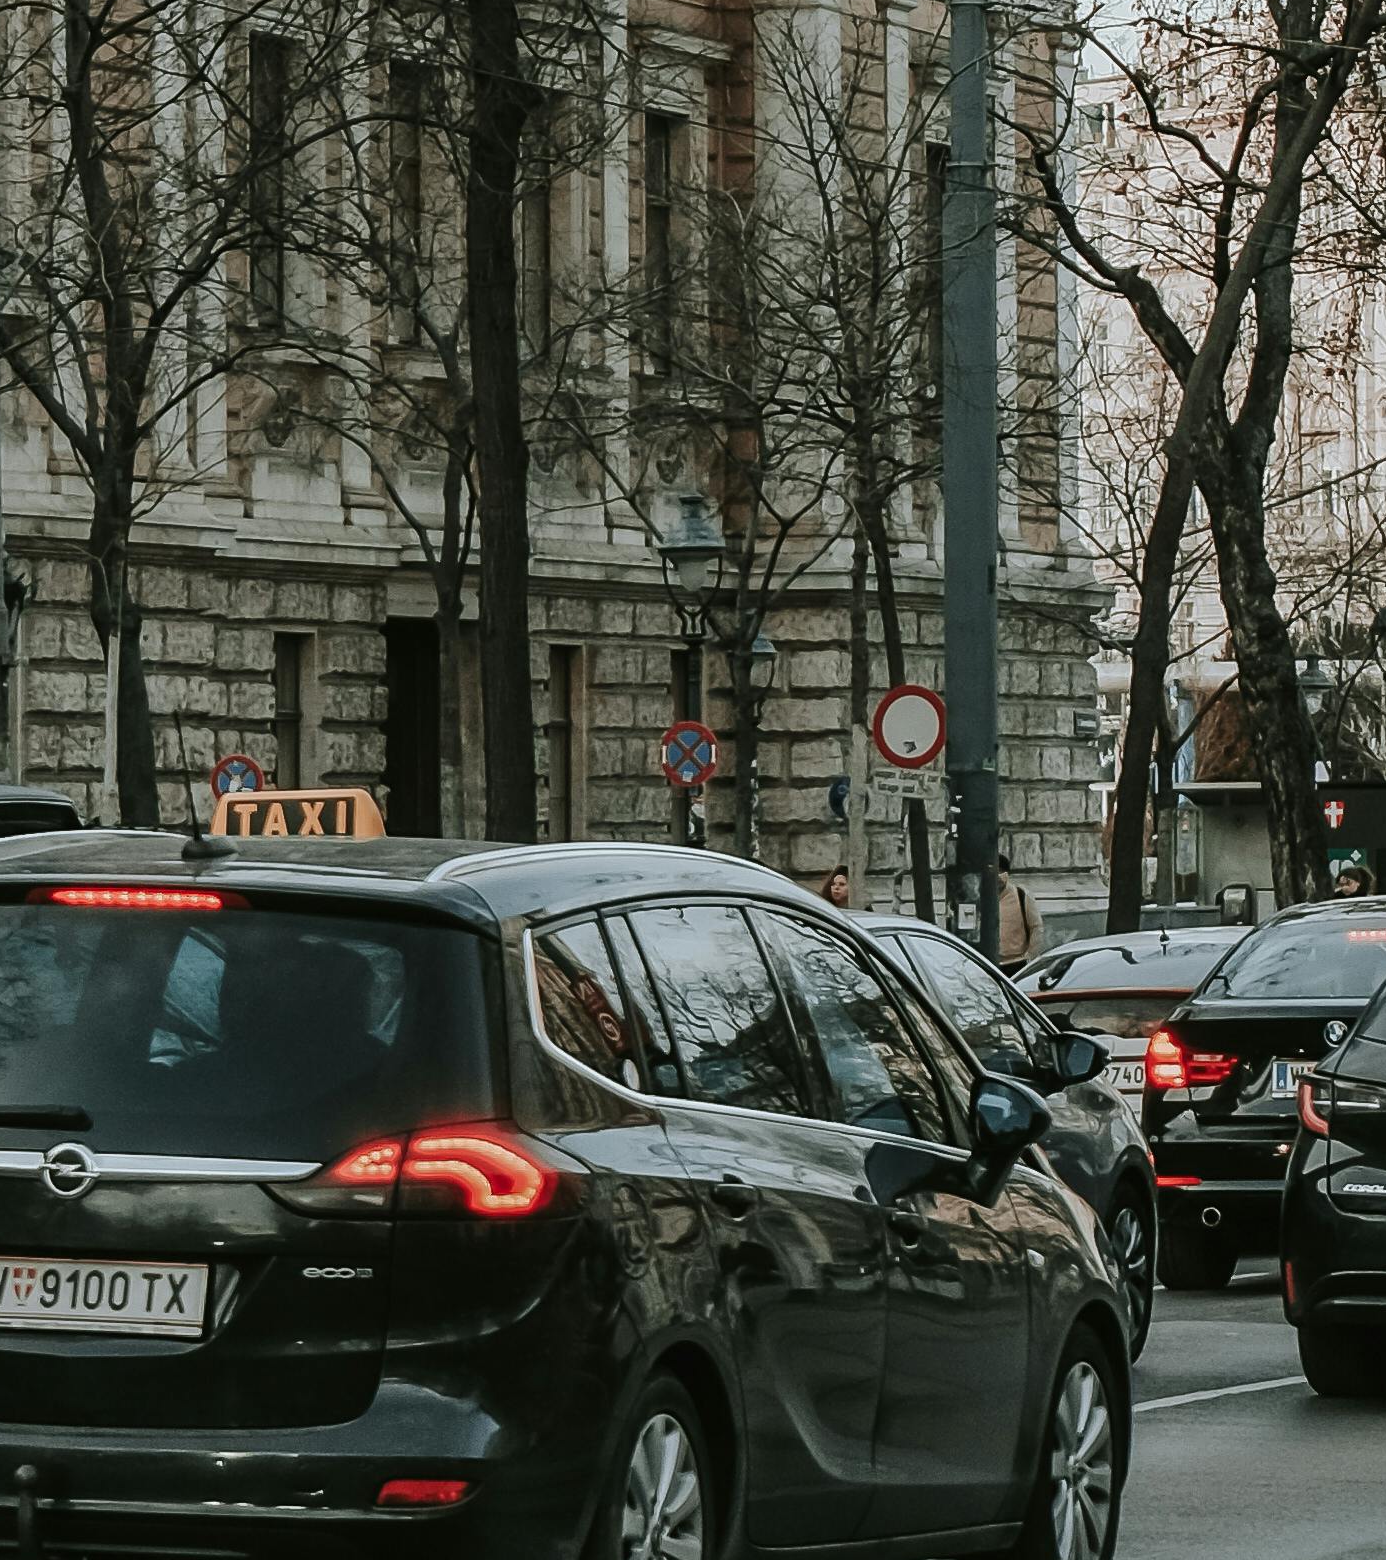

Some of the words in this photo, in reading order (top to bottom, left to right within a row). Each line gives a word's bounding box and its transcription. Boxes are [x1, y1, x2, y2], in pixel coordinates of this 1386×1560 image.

[232, 799, 347, 839] TAXI
[40, 1268, 130, 1311] 9100
[142, 1271, 186, 1314] TX
